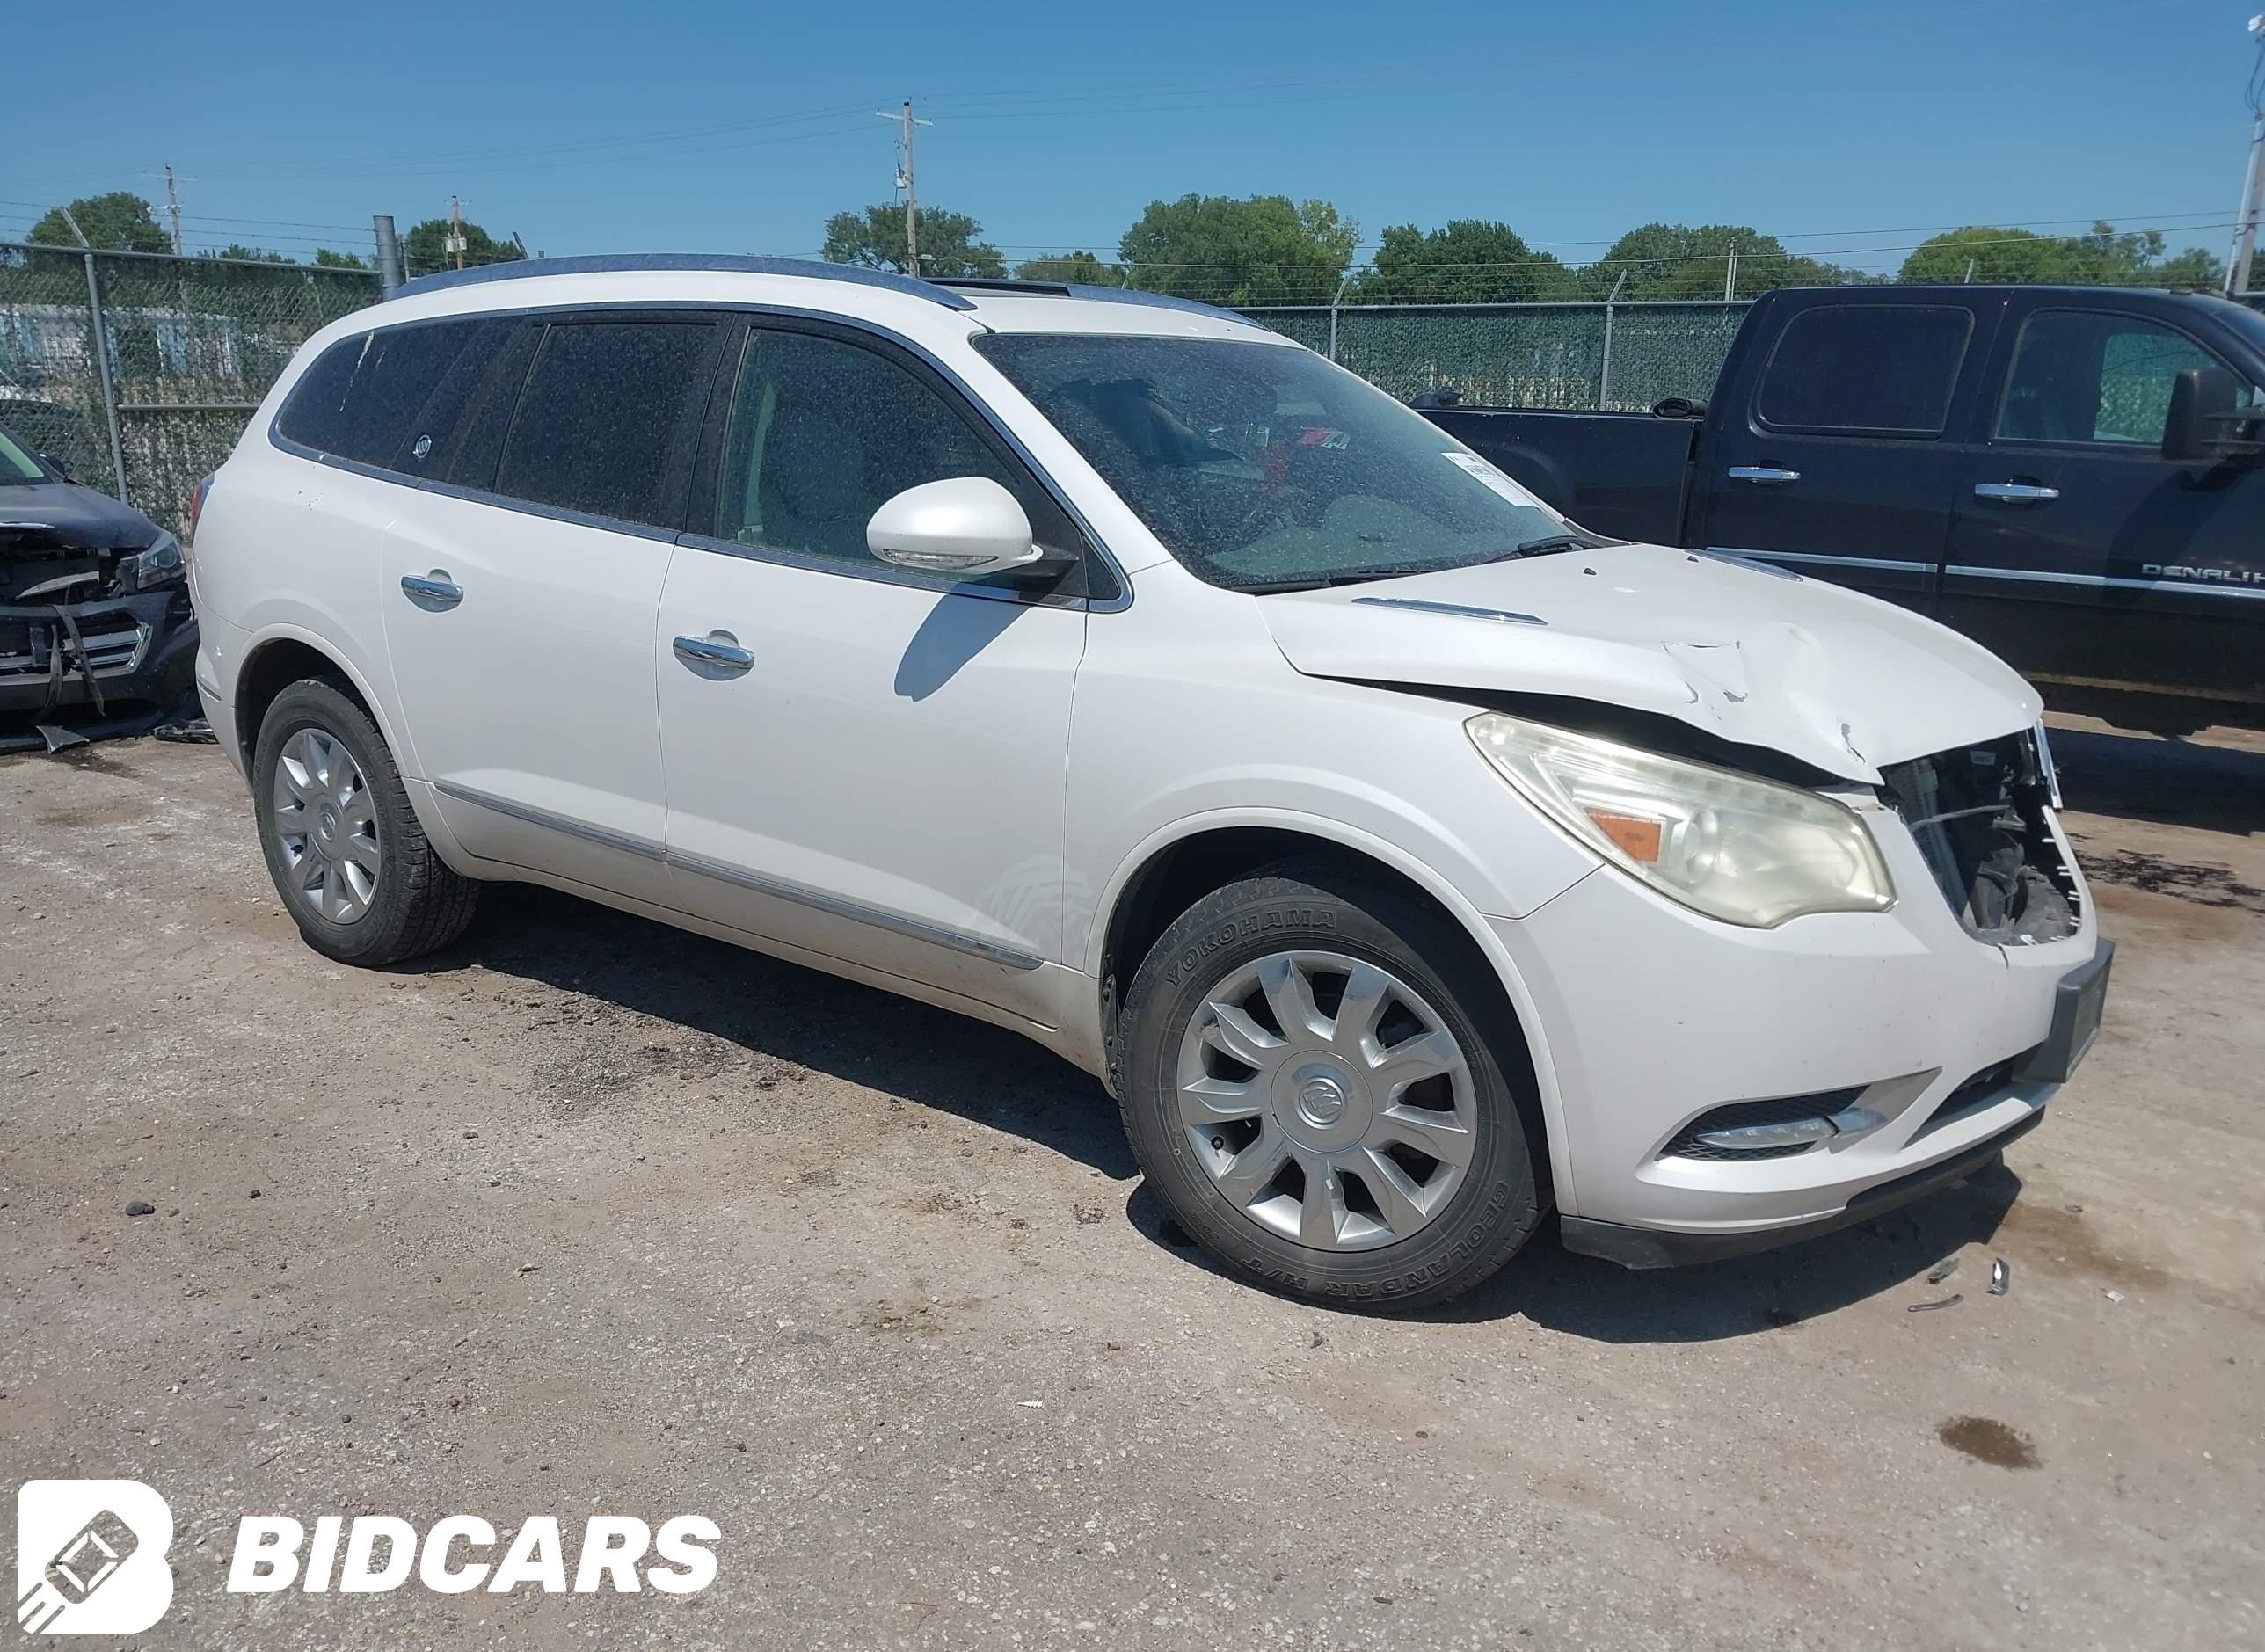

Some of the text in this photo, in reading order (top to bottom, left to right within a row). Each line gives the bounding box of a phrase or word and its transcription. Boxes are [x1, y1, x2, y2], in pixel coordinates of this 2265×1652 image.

[2142, 564, 2251, 583] DENALI
[1165, 907, 1337, 986] YOKOHAMA
[1240, 1181, 1508, 1297] GEOLANDAR H/T
